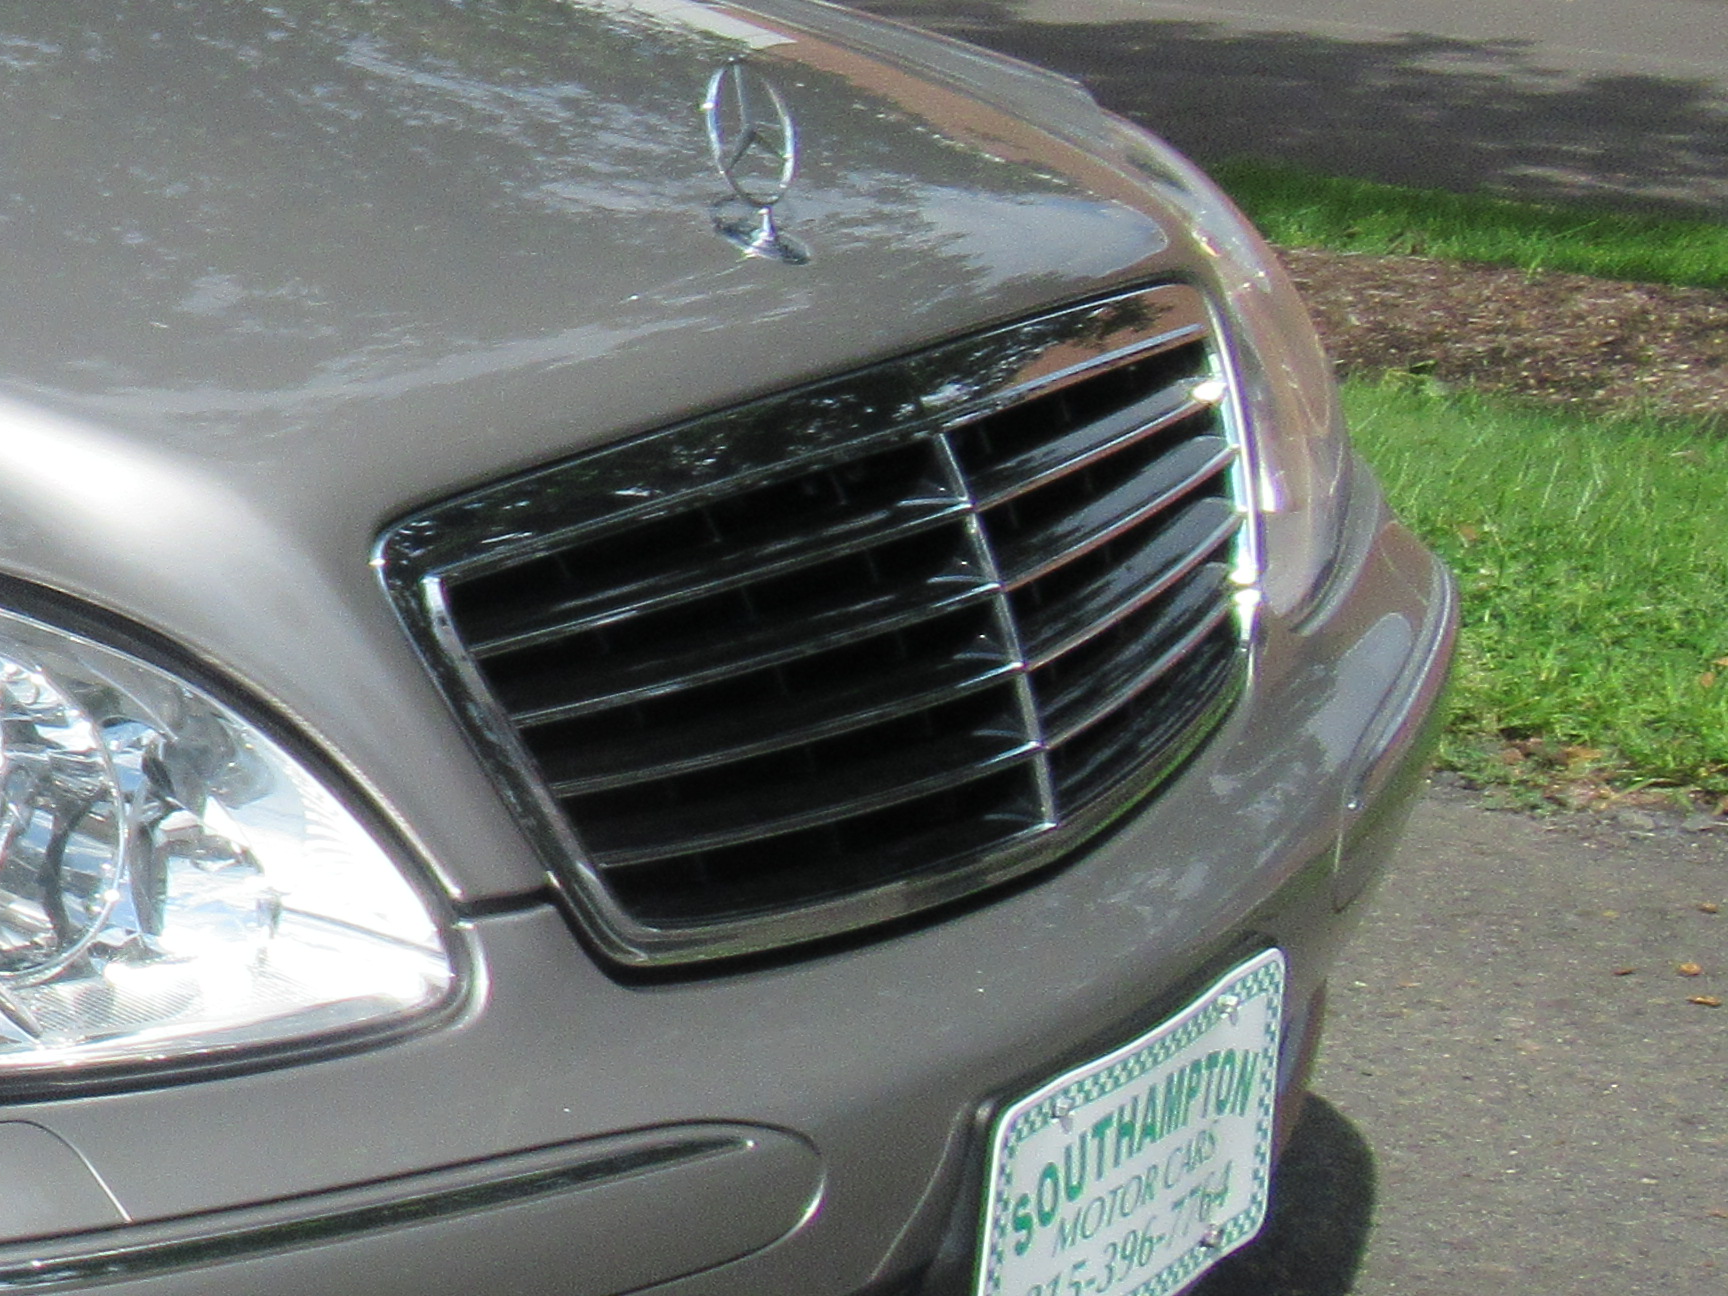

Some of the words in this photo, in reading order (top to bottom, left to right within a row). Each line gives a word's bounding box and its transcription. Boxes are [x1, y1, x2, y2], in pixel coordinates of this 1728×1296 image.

[1010, 1047, 1259, 1257] SOUTHAMPTON
[1051, 1169, 1160, 1258] MOTOR
[1162, 1122, 1218, 1190] CARS
